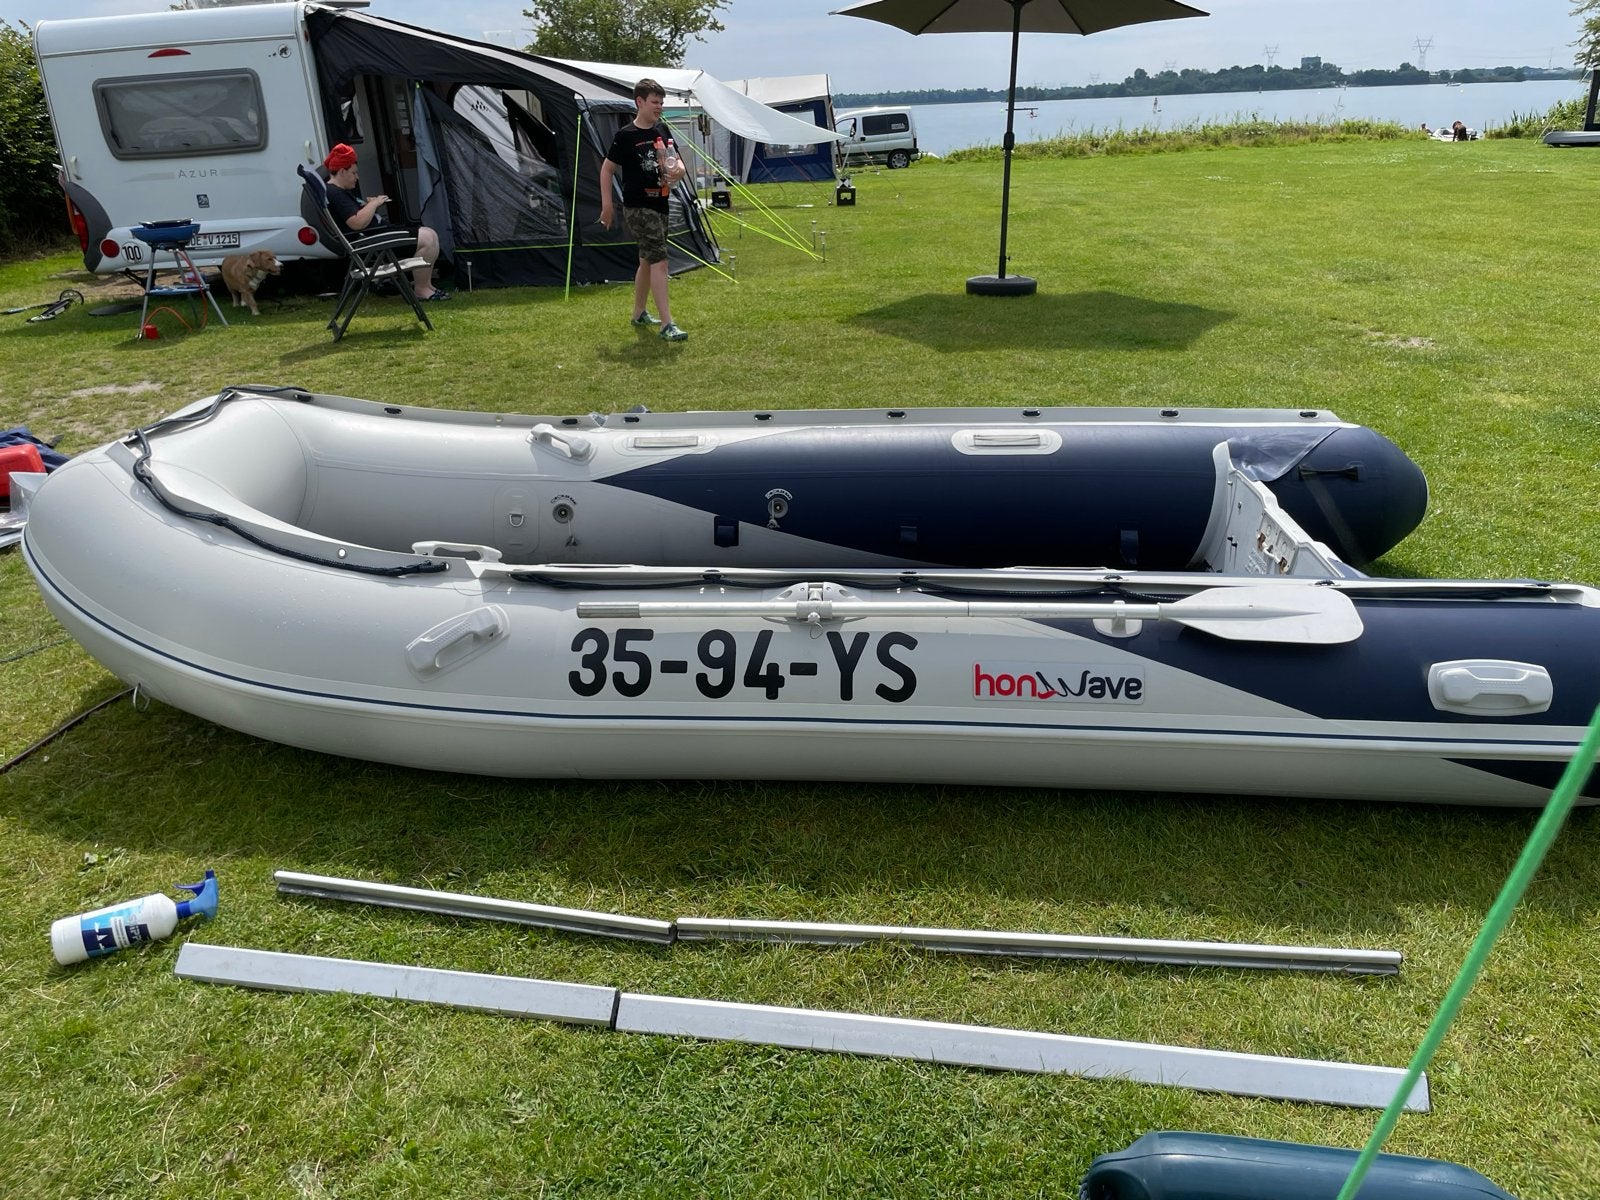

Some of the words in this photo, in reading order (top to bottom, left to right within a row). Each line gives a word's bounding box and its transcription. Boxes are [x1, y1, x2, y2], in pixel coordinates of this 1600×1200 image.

[178, 169, 218, 178] AZUR
[208, 235, 214, 244] V
[215, 233, 238, 245] 1215
[121, 245, 142, 261] 100
[568, 627, 918, 703] 35-94-YS
